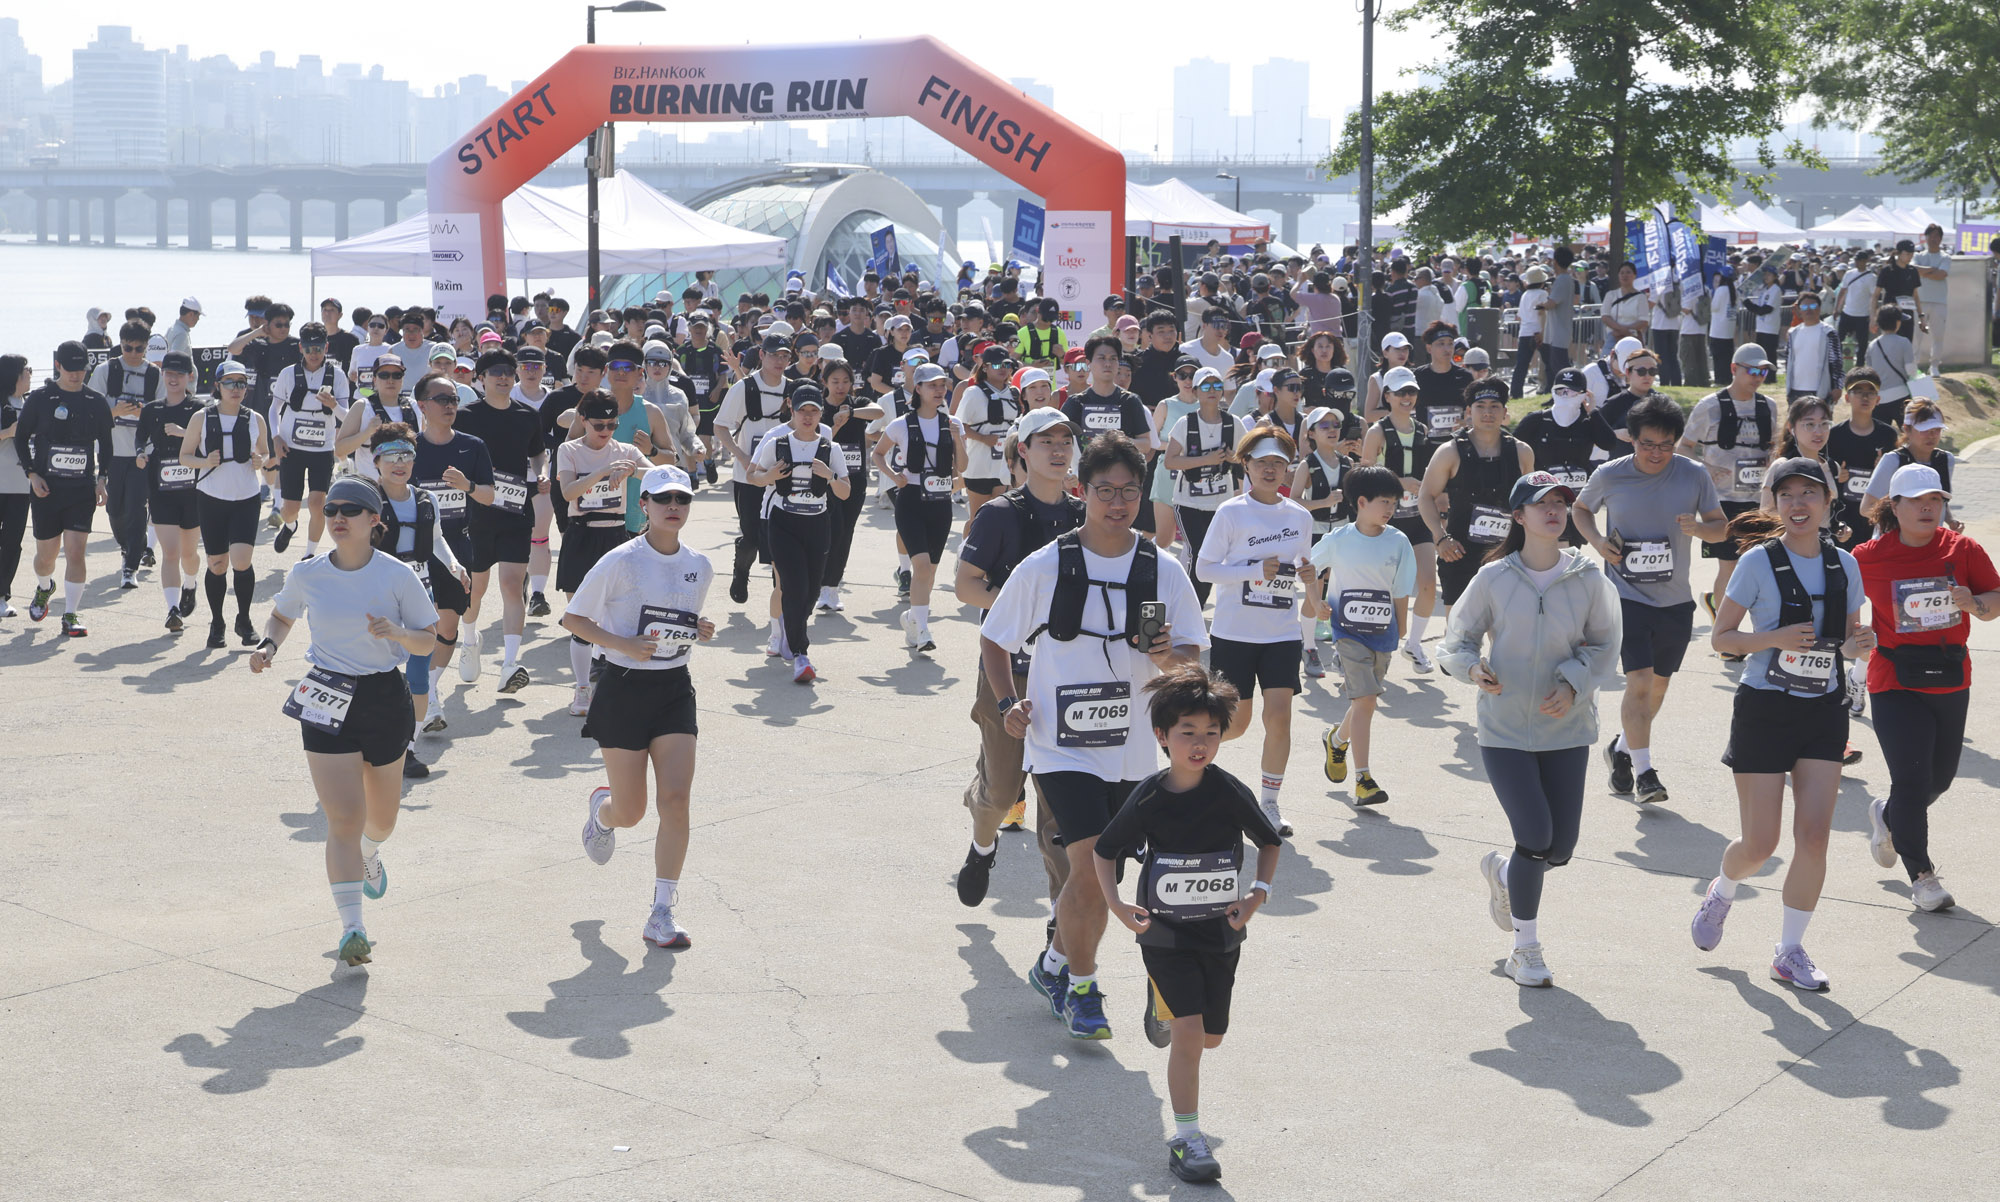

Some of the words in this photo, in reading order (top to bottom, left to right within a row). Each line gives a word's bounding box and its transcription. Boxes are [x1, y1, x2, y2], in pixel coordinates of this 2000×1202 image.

[610, 82, 774, 115] BURNING
[786, 78, 868, 111] RUN
[458, 82, 557, 175] START
[917, 75, 1052, 173] FINISH
[1703, 248, 1727, 268] 근식
[434, 280, 463, 291] Maxim
[305, 428, 325, 436] 7244
[64, 456, 86, 465] 7090
[172, 467, 194, 476] 7597
[1742, 471, 1750, 479] M
[501, 486, 526, 498] 7074
[595, 484, 619, 493] 76
[437, 492, 465, 502] 7103
[1247, 533, 1282, 547] Burning
[1282, 527, 1299, 539] Run
[1642, 553, 1670, 565] 7071
[1266, 579, 1294, 590] 7907
[1910, 600, 1920, 609] W
[644, 609, 667, 618] BURNING
[1349, 606, 1358, 614] M
[1361, 605, 1391, 617] 7070
[650, 629, 661, 637] W
[664, 628, 697, 641] 7654
[1785, 654, 1797, 664] W
[1800, 655, 1832, 669] 7765
[298, 684, 310, 694] W
[310, 687, 349, 710] 7677
[1060, 688, 1089, 696] BURNING
[1072, 710, 1083, 720] M
[1088, 704, 1129, 720] 7069
[1156, 857, 1185, 866] BURNING
[1165, 882, 1178, 893] M
[1184, 877, 1235, 893] 7068
